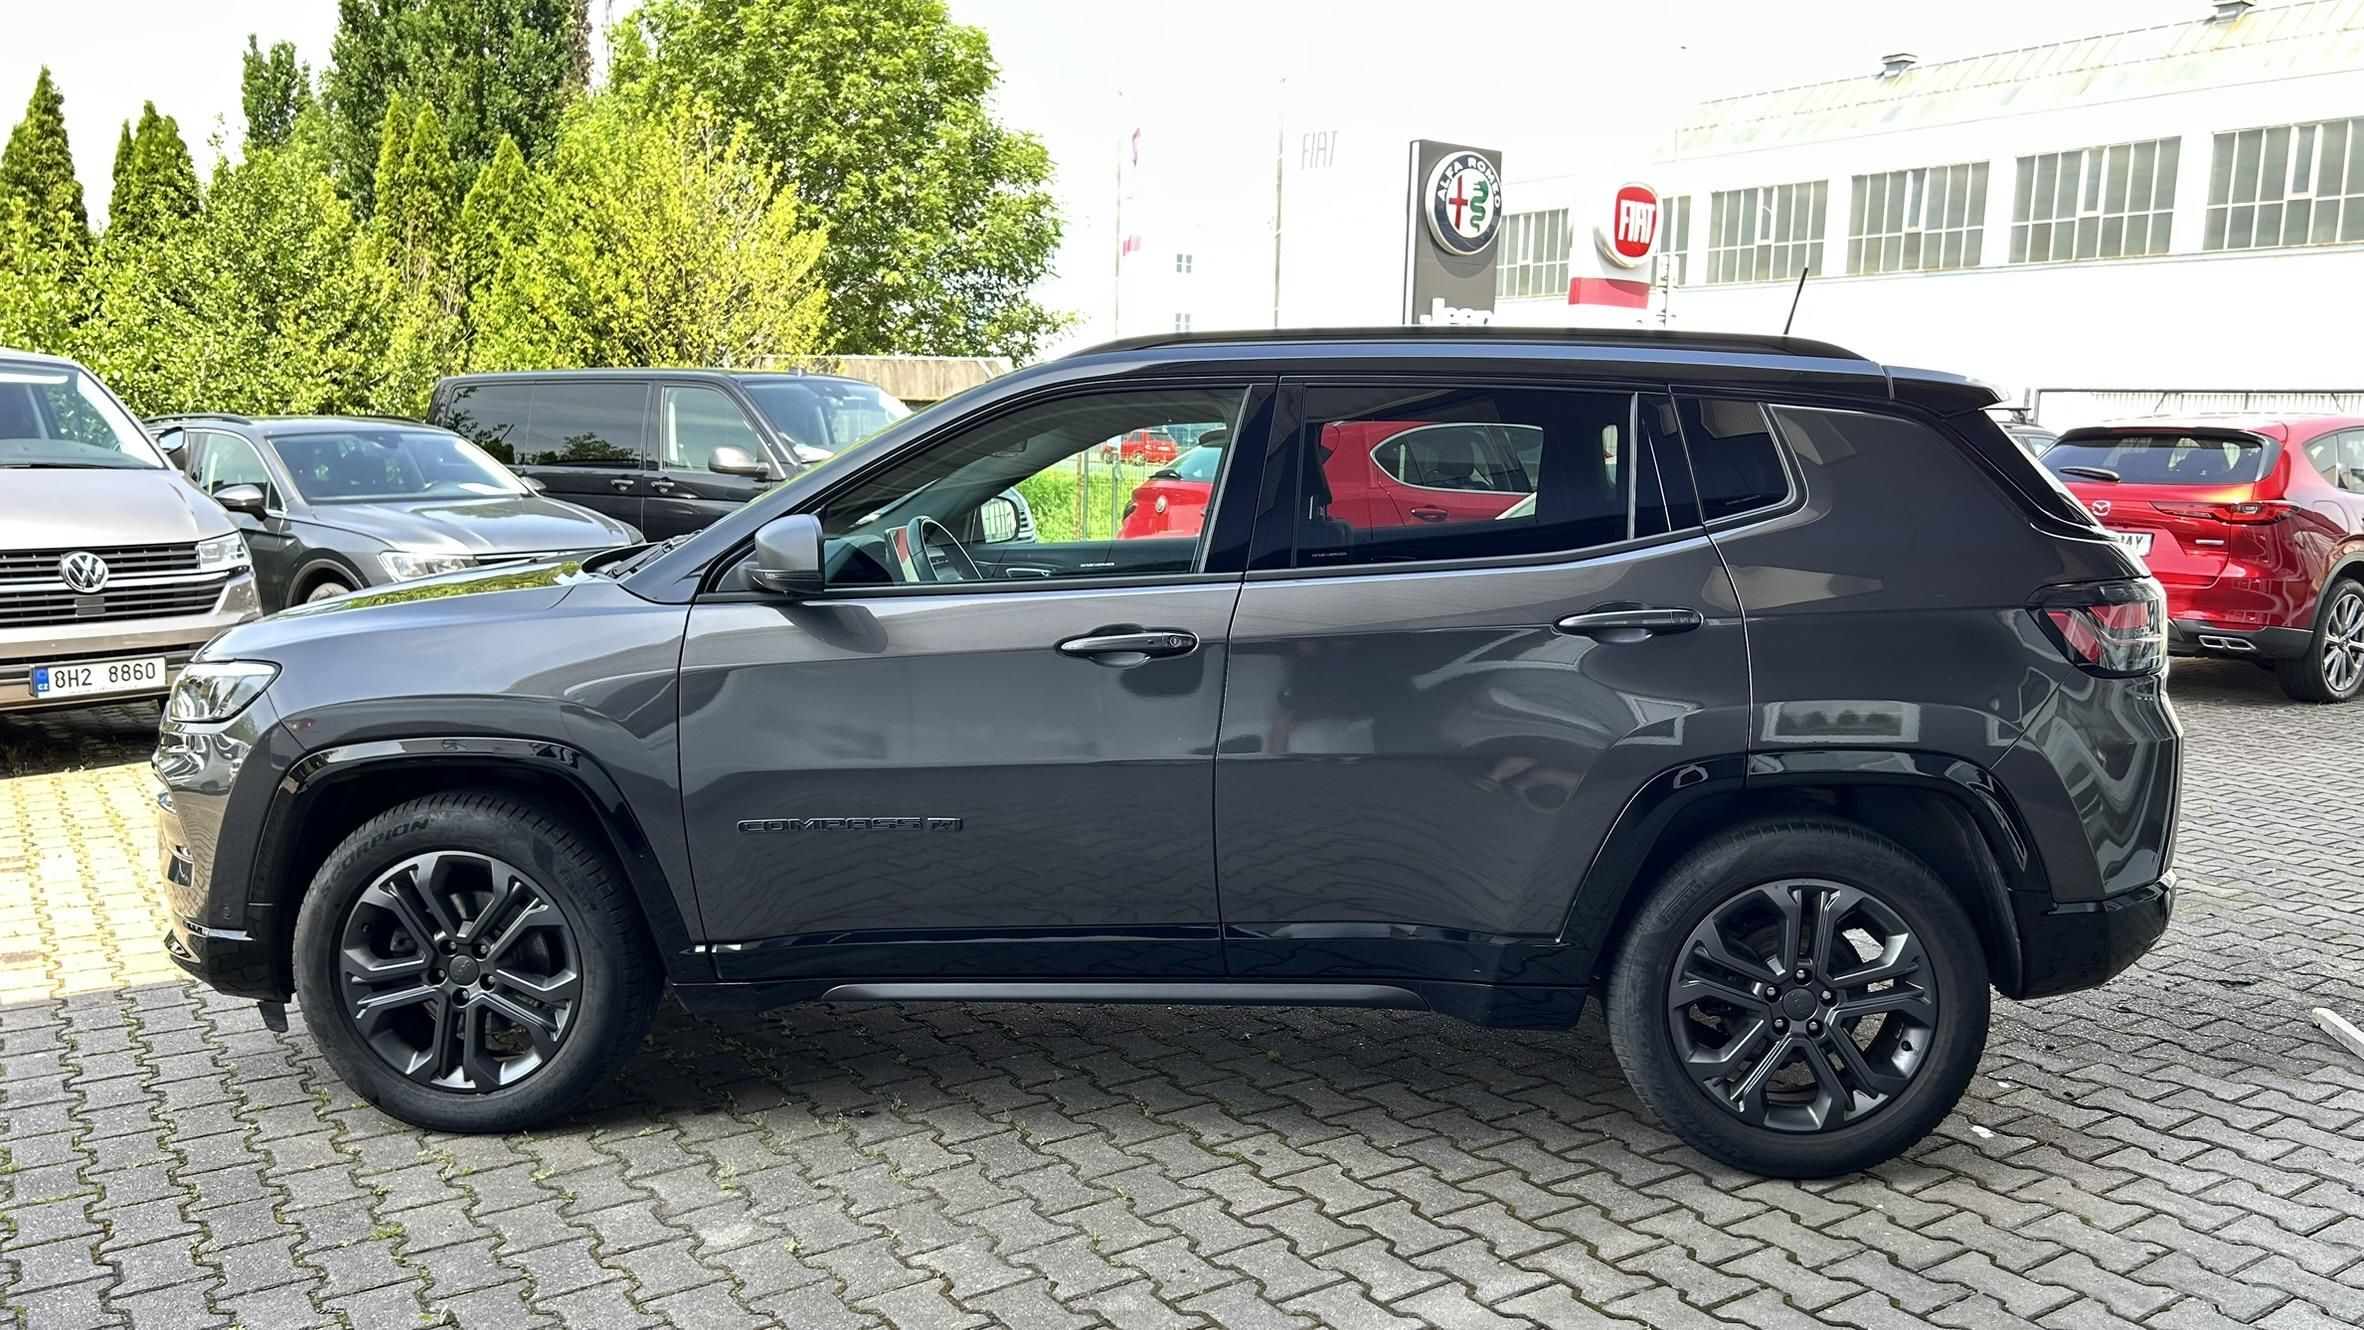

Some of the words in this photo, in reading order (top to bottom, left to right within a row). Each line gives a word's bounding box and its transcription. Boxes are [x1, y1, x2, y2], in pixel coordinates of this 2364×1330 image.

[1301, 130, 1340, 170] FIAT
[1437, 160, 1463, 201] ALFA
[1467, 157, 1501, 208] ROMEO
[1618, 199, 1656, 245] FIAT
[37, 683, 49, 691] CZ
[54, 668, 93, 689] 8H2
[108, 662, 156, 683] 8860
[737, 817, 923, 833] COMPASS
[320, 819, 430, 897] SCORPION
